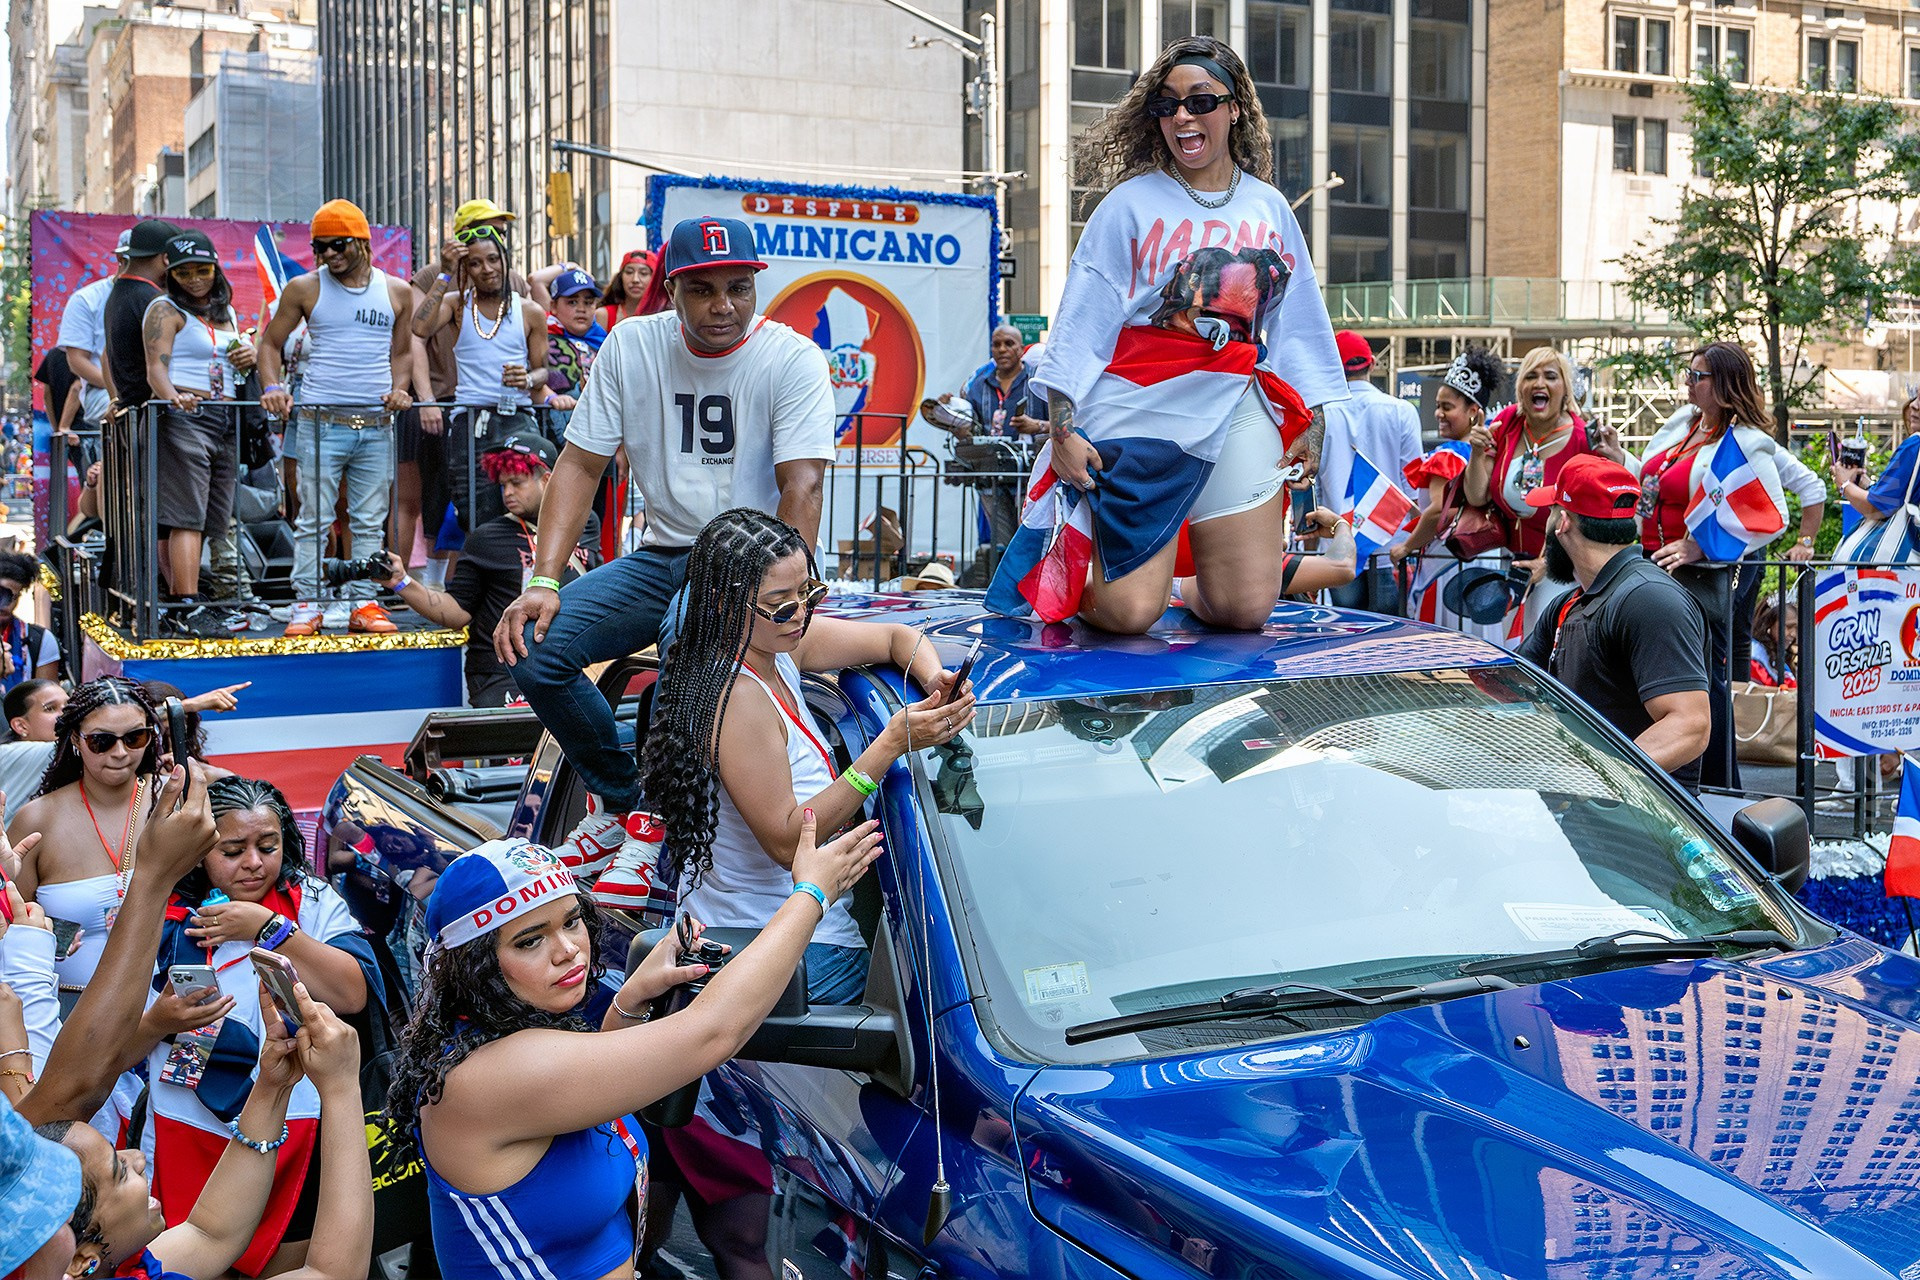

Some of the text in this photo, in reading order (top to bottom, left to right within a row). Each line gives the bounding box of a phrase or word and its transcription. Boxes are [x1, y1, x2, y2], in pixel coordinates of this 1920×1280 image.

[755, 196, 906, 222] DESFILE
[674, 393, 736, 455] 19
[1829, 607, 1881, 652] GRAN
[1825, 641, 1892, 680] DESFILE
[1842, 665, 1882, 701] 2025
[1829, 707, 1855, 718] INICIA:
[1857, 705, 1875, 716] EAST
[1875, 704, 1891, 715] 33RD
[1861, 719, 1878, 730] INFO:
[1051, 971, 1060, 983] 1
